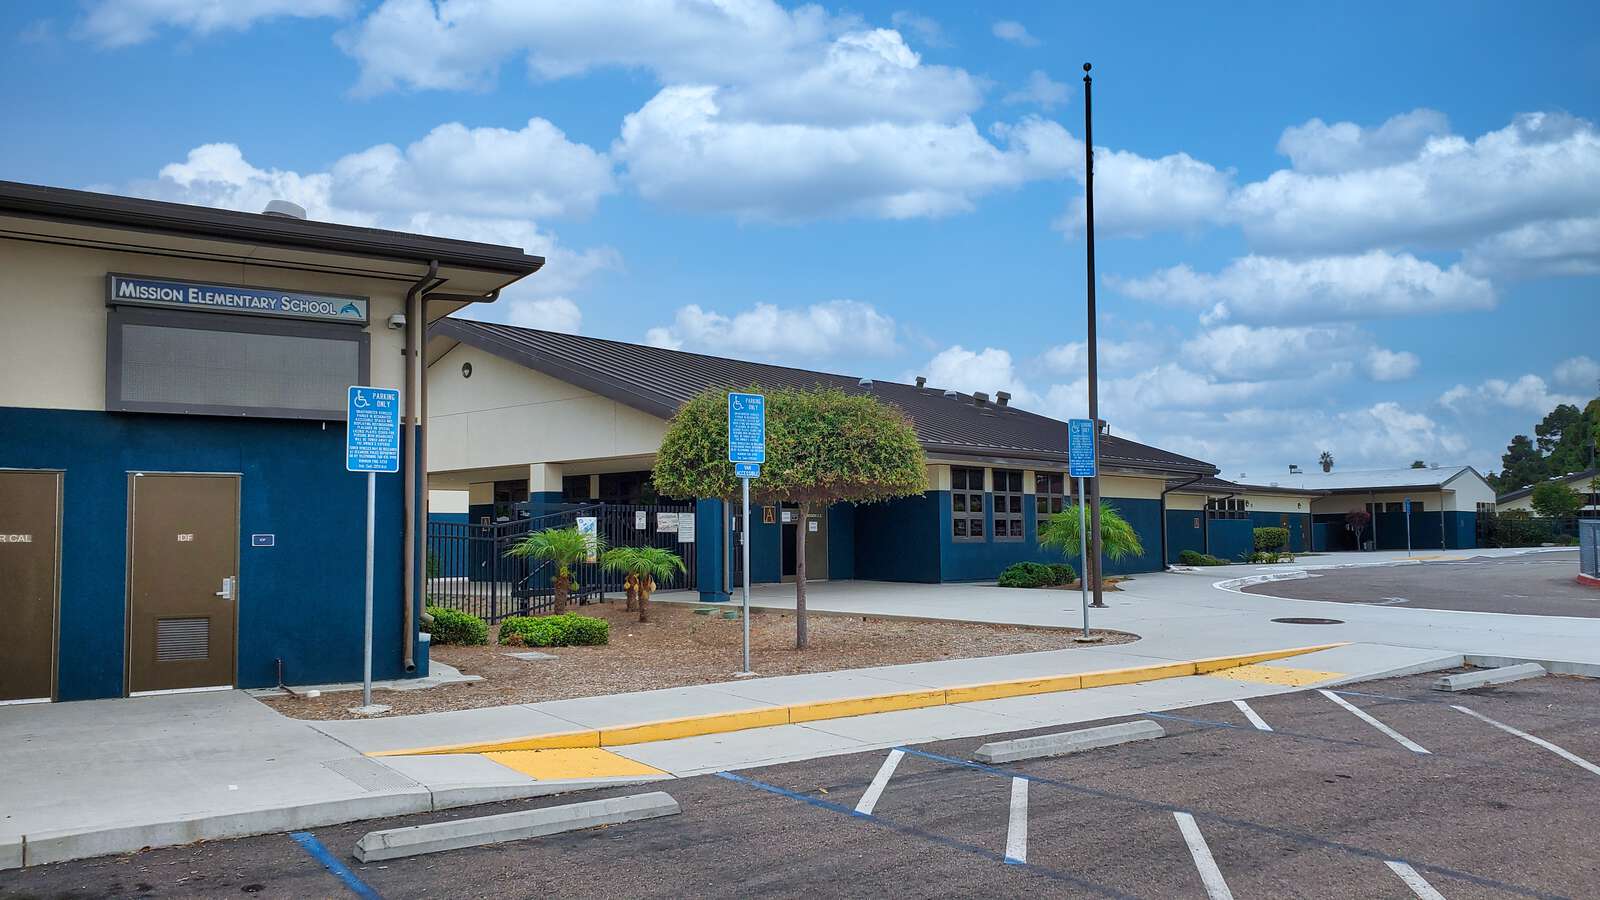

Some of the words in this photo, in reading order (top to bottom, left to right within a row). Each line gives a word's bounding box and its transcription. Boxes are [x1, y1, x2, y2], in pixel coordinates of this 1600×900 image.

[118, 281, 184, 302] MISSION
[188, 287, 277, 310] ELEMENTARY
[280, 295, 338, 316] SCHOOL
[372, 392, 395, 401] PARKING
[376, 400, 391, 408] ONLY
